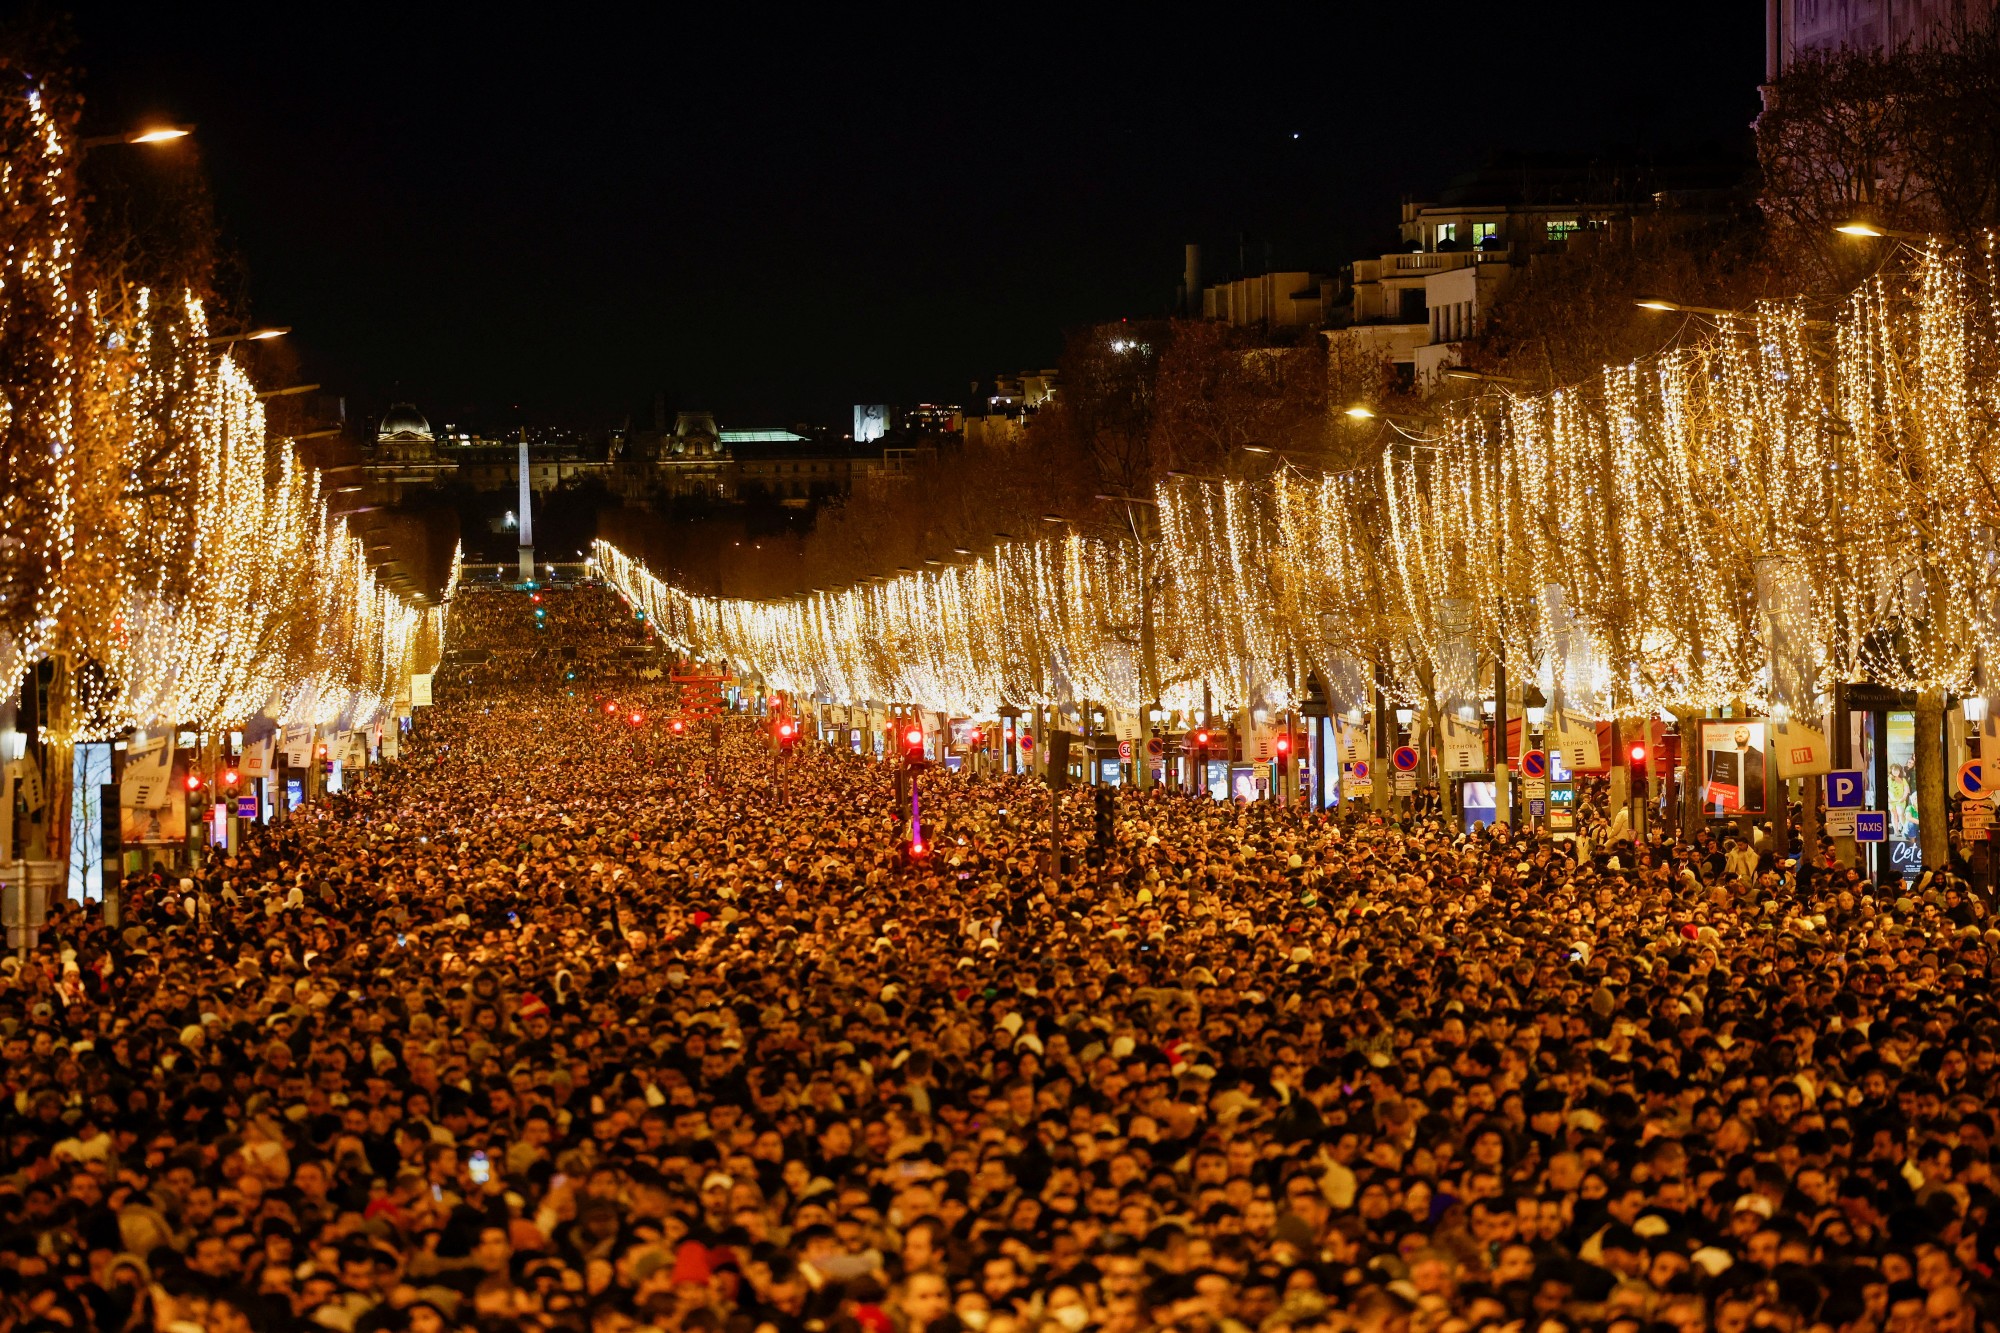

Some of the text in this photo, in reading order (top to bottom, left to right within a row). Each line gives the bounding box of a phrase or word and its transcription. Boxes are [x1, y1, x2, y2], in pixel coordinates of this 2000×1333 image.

[1793, 749, 1812, 763] RTL
[1551, 790, 1572, 801] 24/24
[1836, 778, 1854, 802] P
[238, 803, 256, 811] TAXIS
[1857, 822, 1883, 832] TAXIS
